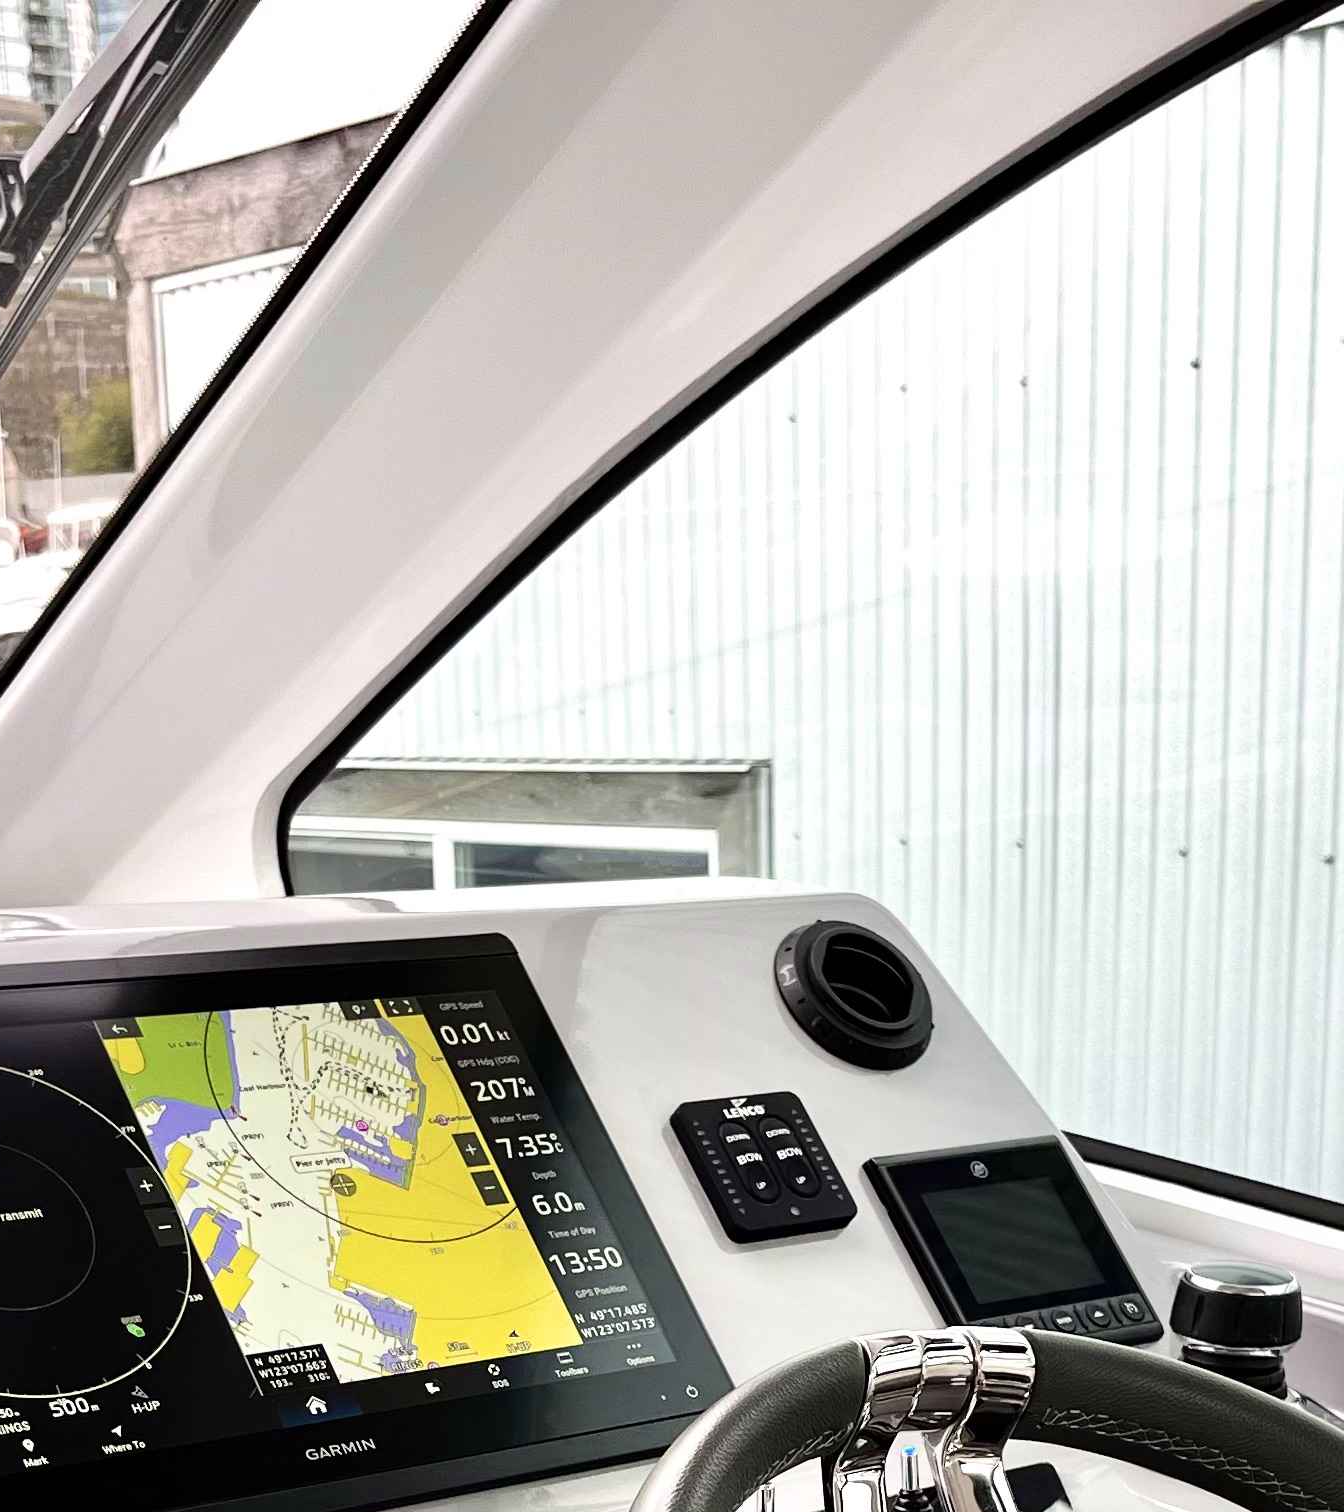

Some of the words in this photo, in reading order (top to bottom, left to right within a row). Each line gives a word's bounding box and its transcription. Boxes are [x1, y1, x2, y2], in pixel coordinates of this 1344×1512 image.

[439, 1001, 457, 1011] GPS
[458, 1000, 484, 1010] Speed
[457, 1058, 476, 1068] GPS
[723, 1104, 765, 1120] LENCO
[490, 1114, 515, 1124] Water
[736, 1152, 763, 1165] BOW
[776, 1147, 803, 1160] BOW
[531, 1170, 558, 1181] Depth
[548, 1229, 570, 1239] Time
[570, 1227, 579, 1236] of
[580, 1226, 597, 1237] Day
[548, 1246, 624, 1276] 13:50
[574, 1288, 594, 1299] GPS
[594, 1284, 628, 1296] Position
[574, 1312, 586, 1324] N
[254, 1357, 264, 1367] N
[626, 1354, 656, 1368] Options
[555, 1364, 590, 1379] Toolbars
[491, 1378, 510, 1390] SOS
[131, 1400, 161, 1415] H-UP
[102, 1442, 129, 1456] Where
[131, 1440, 146, 1451] To
[306, 1438, 377, 1461] GARMIN
[23, 1455, 50, 1469] Mark
